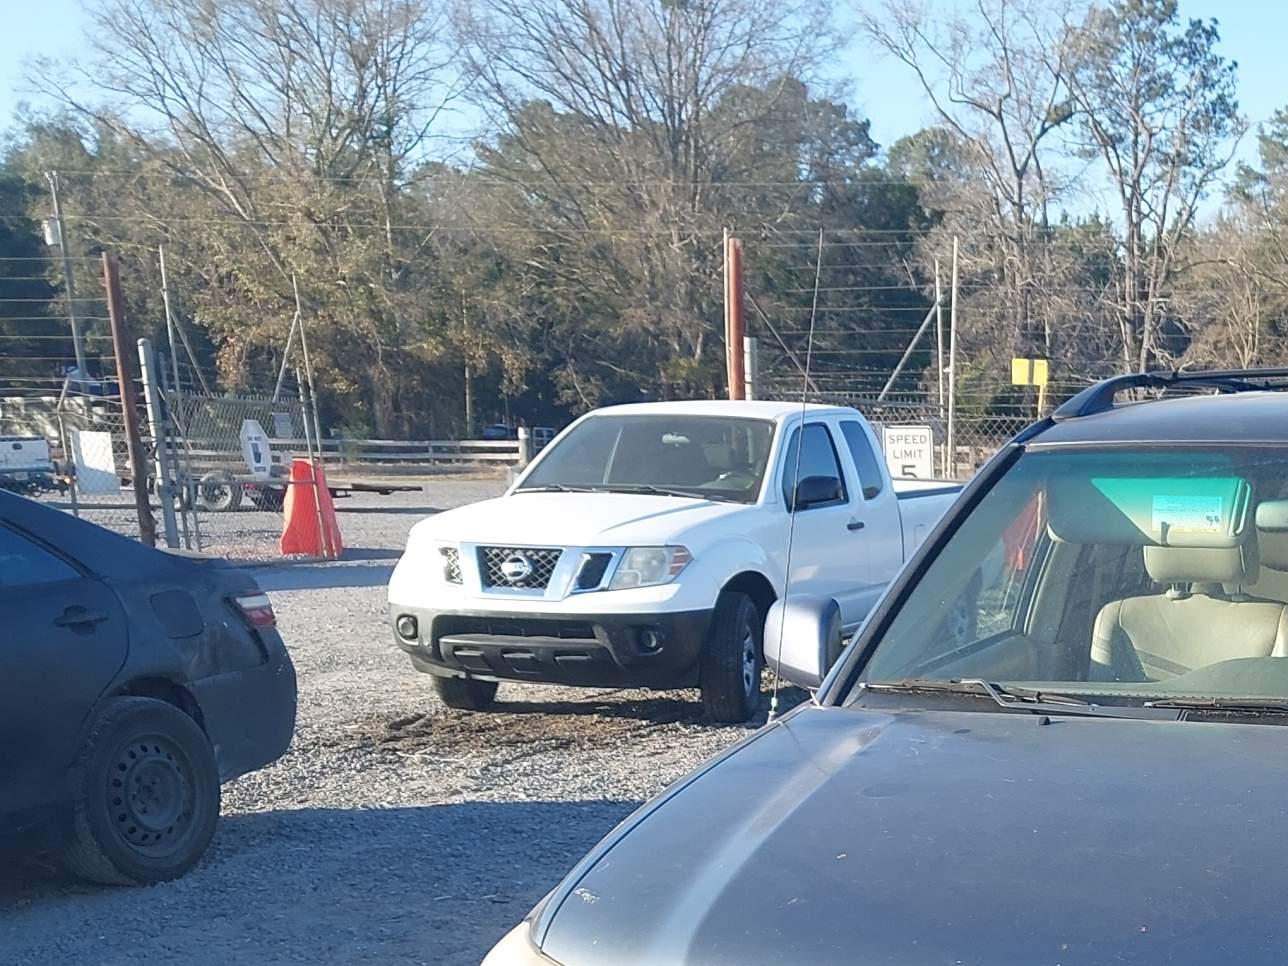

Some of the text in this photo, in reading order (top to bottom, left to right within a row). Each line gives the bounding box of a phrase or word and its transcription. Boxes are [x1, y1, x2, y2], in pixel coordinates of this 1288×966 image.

[888, 434, 928, 445] SPEED
[893, 449, 923, 460] LIMIT
[901, 464, 917, 478] 5
